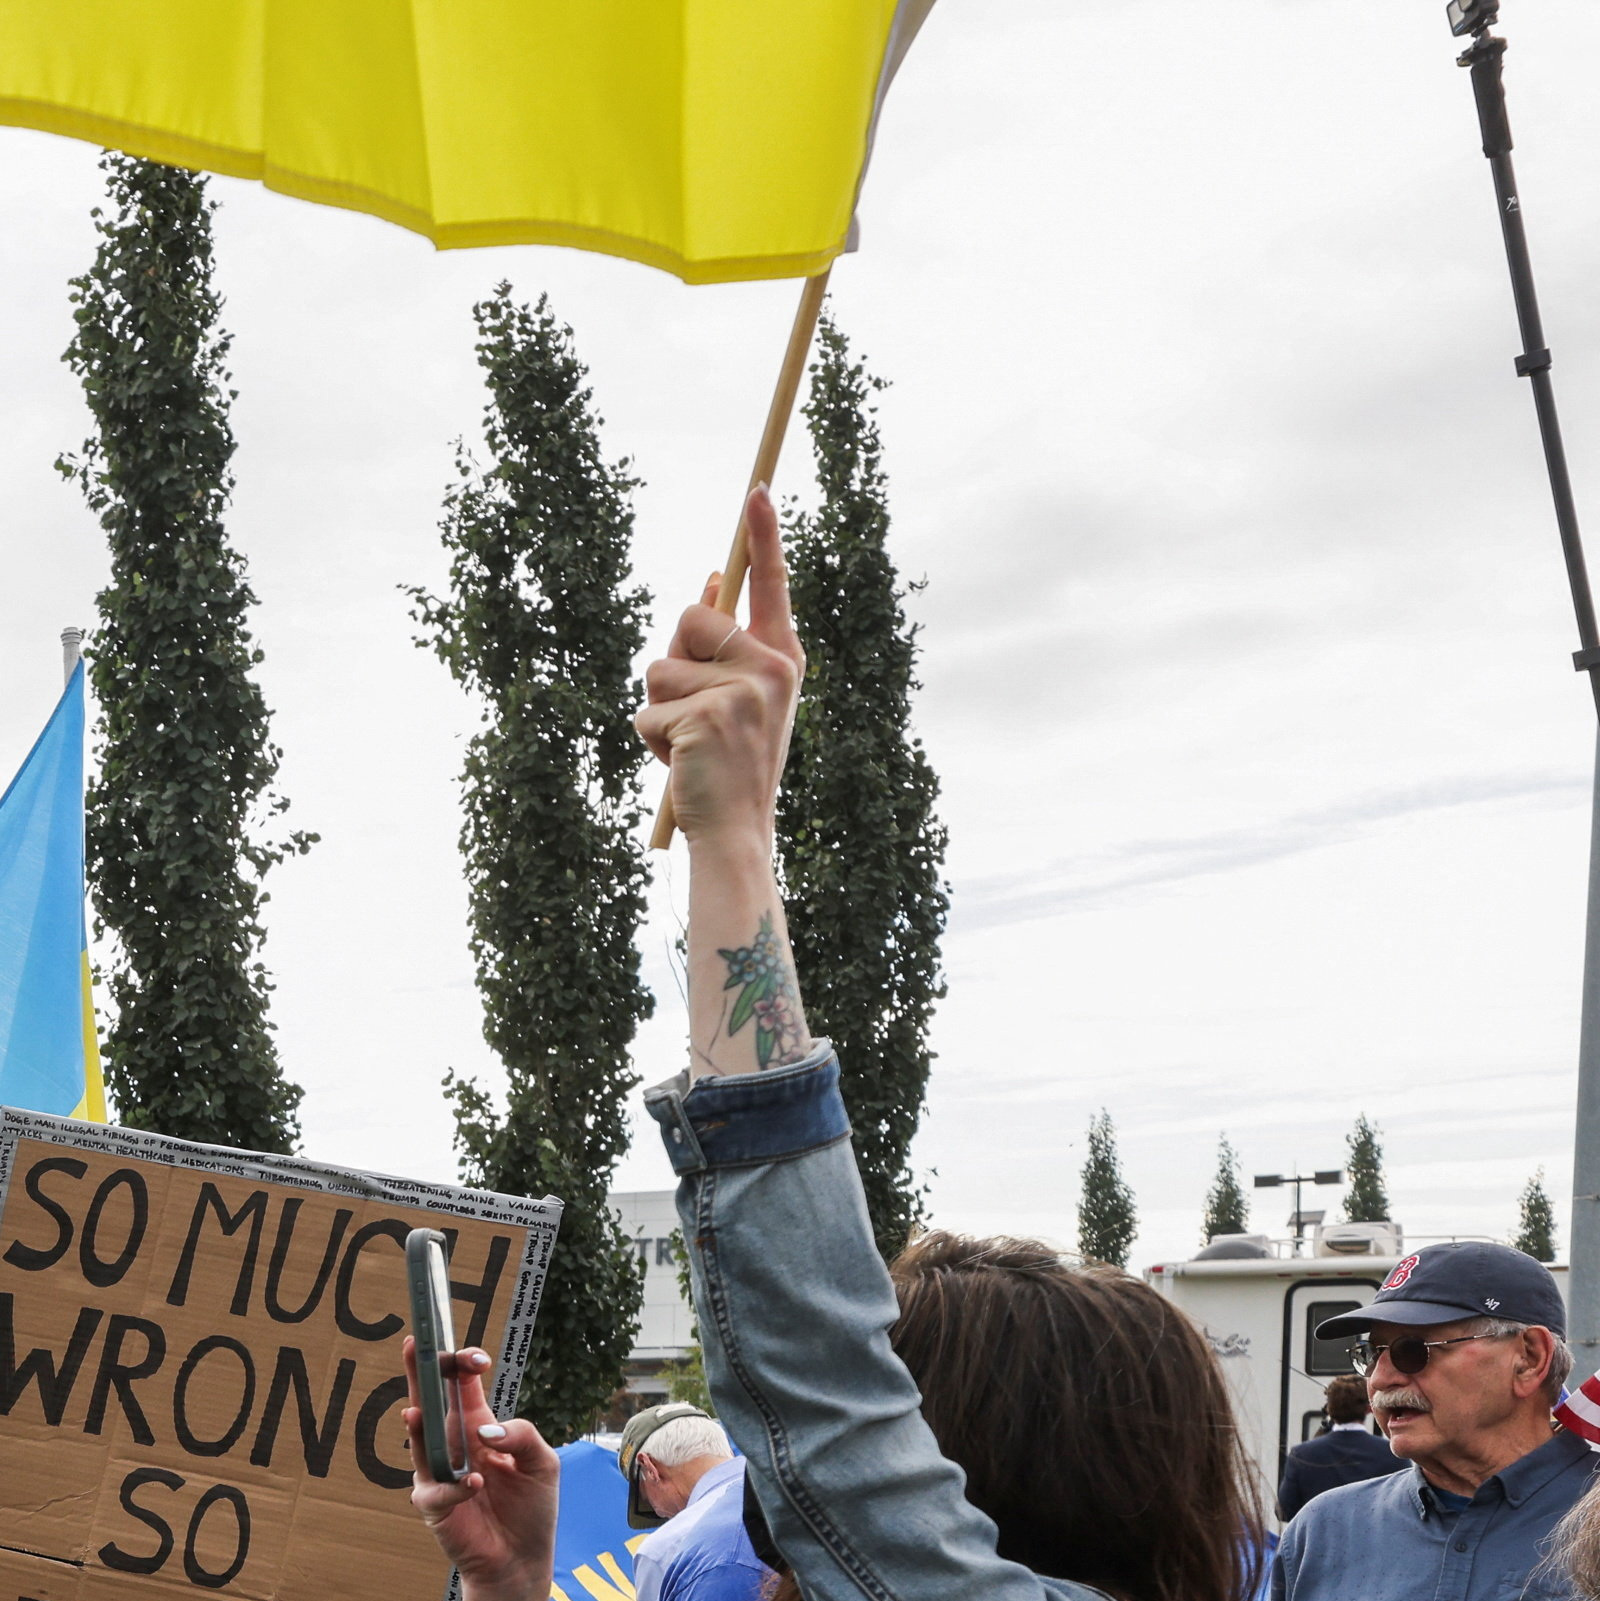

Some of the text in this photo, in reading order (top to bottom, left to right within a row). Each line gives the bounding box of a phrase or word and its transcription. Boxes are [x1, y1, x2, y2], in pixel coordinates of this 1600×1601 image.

[2, 1127, 43, 1139] ATTACKS
[52, 1135, 66, 1143] ON
[73, 1139, 111, 1152] MENTAL
[116, 1146, 175, 1163] HEALTHCARE
[4, 1111, 30, 1125] DOGE
[61, 1123, 99, 1136] ILLEGAL
[144, 1138, 156, 1147] OF
[3, 1157, 511, 1351] SO MUCH
[1382, 1255, 1420, 1291] B
[98, 1467, 250, 1587] SO
